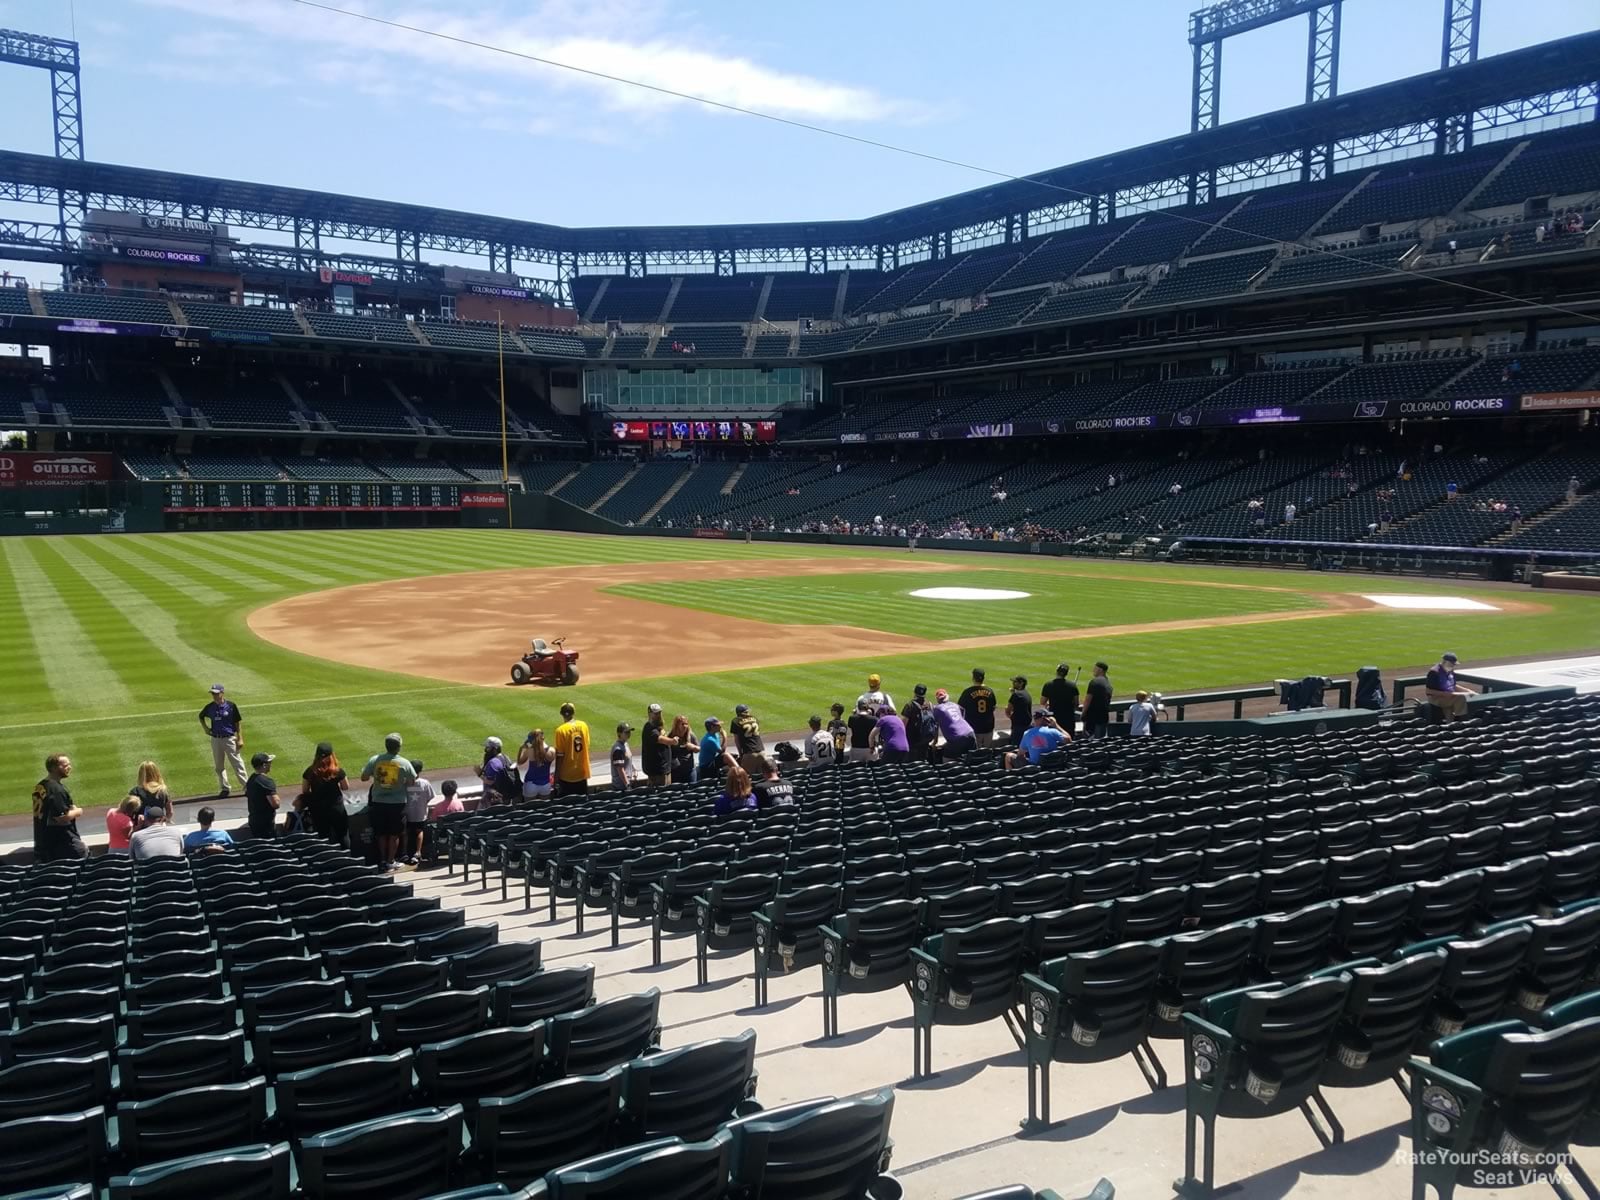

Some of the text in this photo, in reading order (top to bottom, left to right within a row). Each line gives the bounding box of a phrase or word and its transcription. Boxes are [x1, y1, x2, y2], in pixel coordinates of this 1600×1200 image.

[162, 216, 183, 228] JACK
[127, 248, 200, 262] COLORADO ROCKIES
[472, 285, 527, 298] COLORADO ROCKIES
[1400, 398, 1504, 413] COLORADO ROCKIES
[1534, 398, 1557, 406] Ideal
[1559, 397, 1589, 405] Home
[1075, 416, 1151, 430] COLORADO ROCKIES
[898, 431, 920, 439] ROCKIES
[32, 464, 97, 473] OUTBACK
[977, 699, 987, 713] 8
[743, 722, 760, 738] 22
[574, 735, 583, 753] 6
[817, 740, 832, 758] 21
